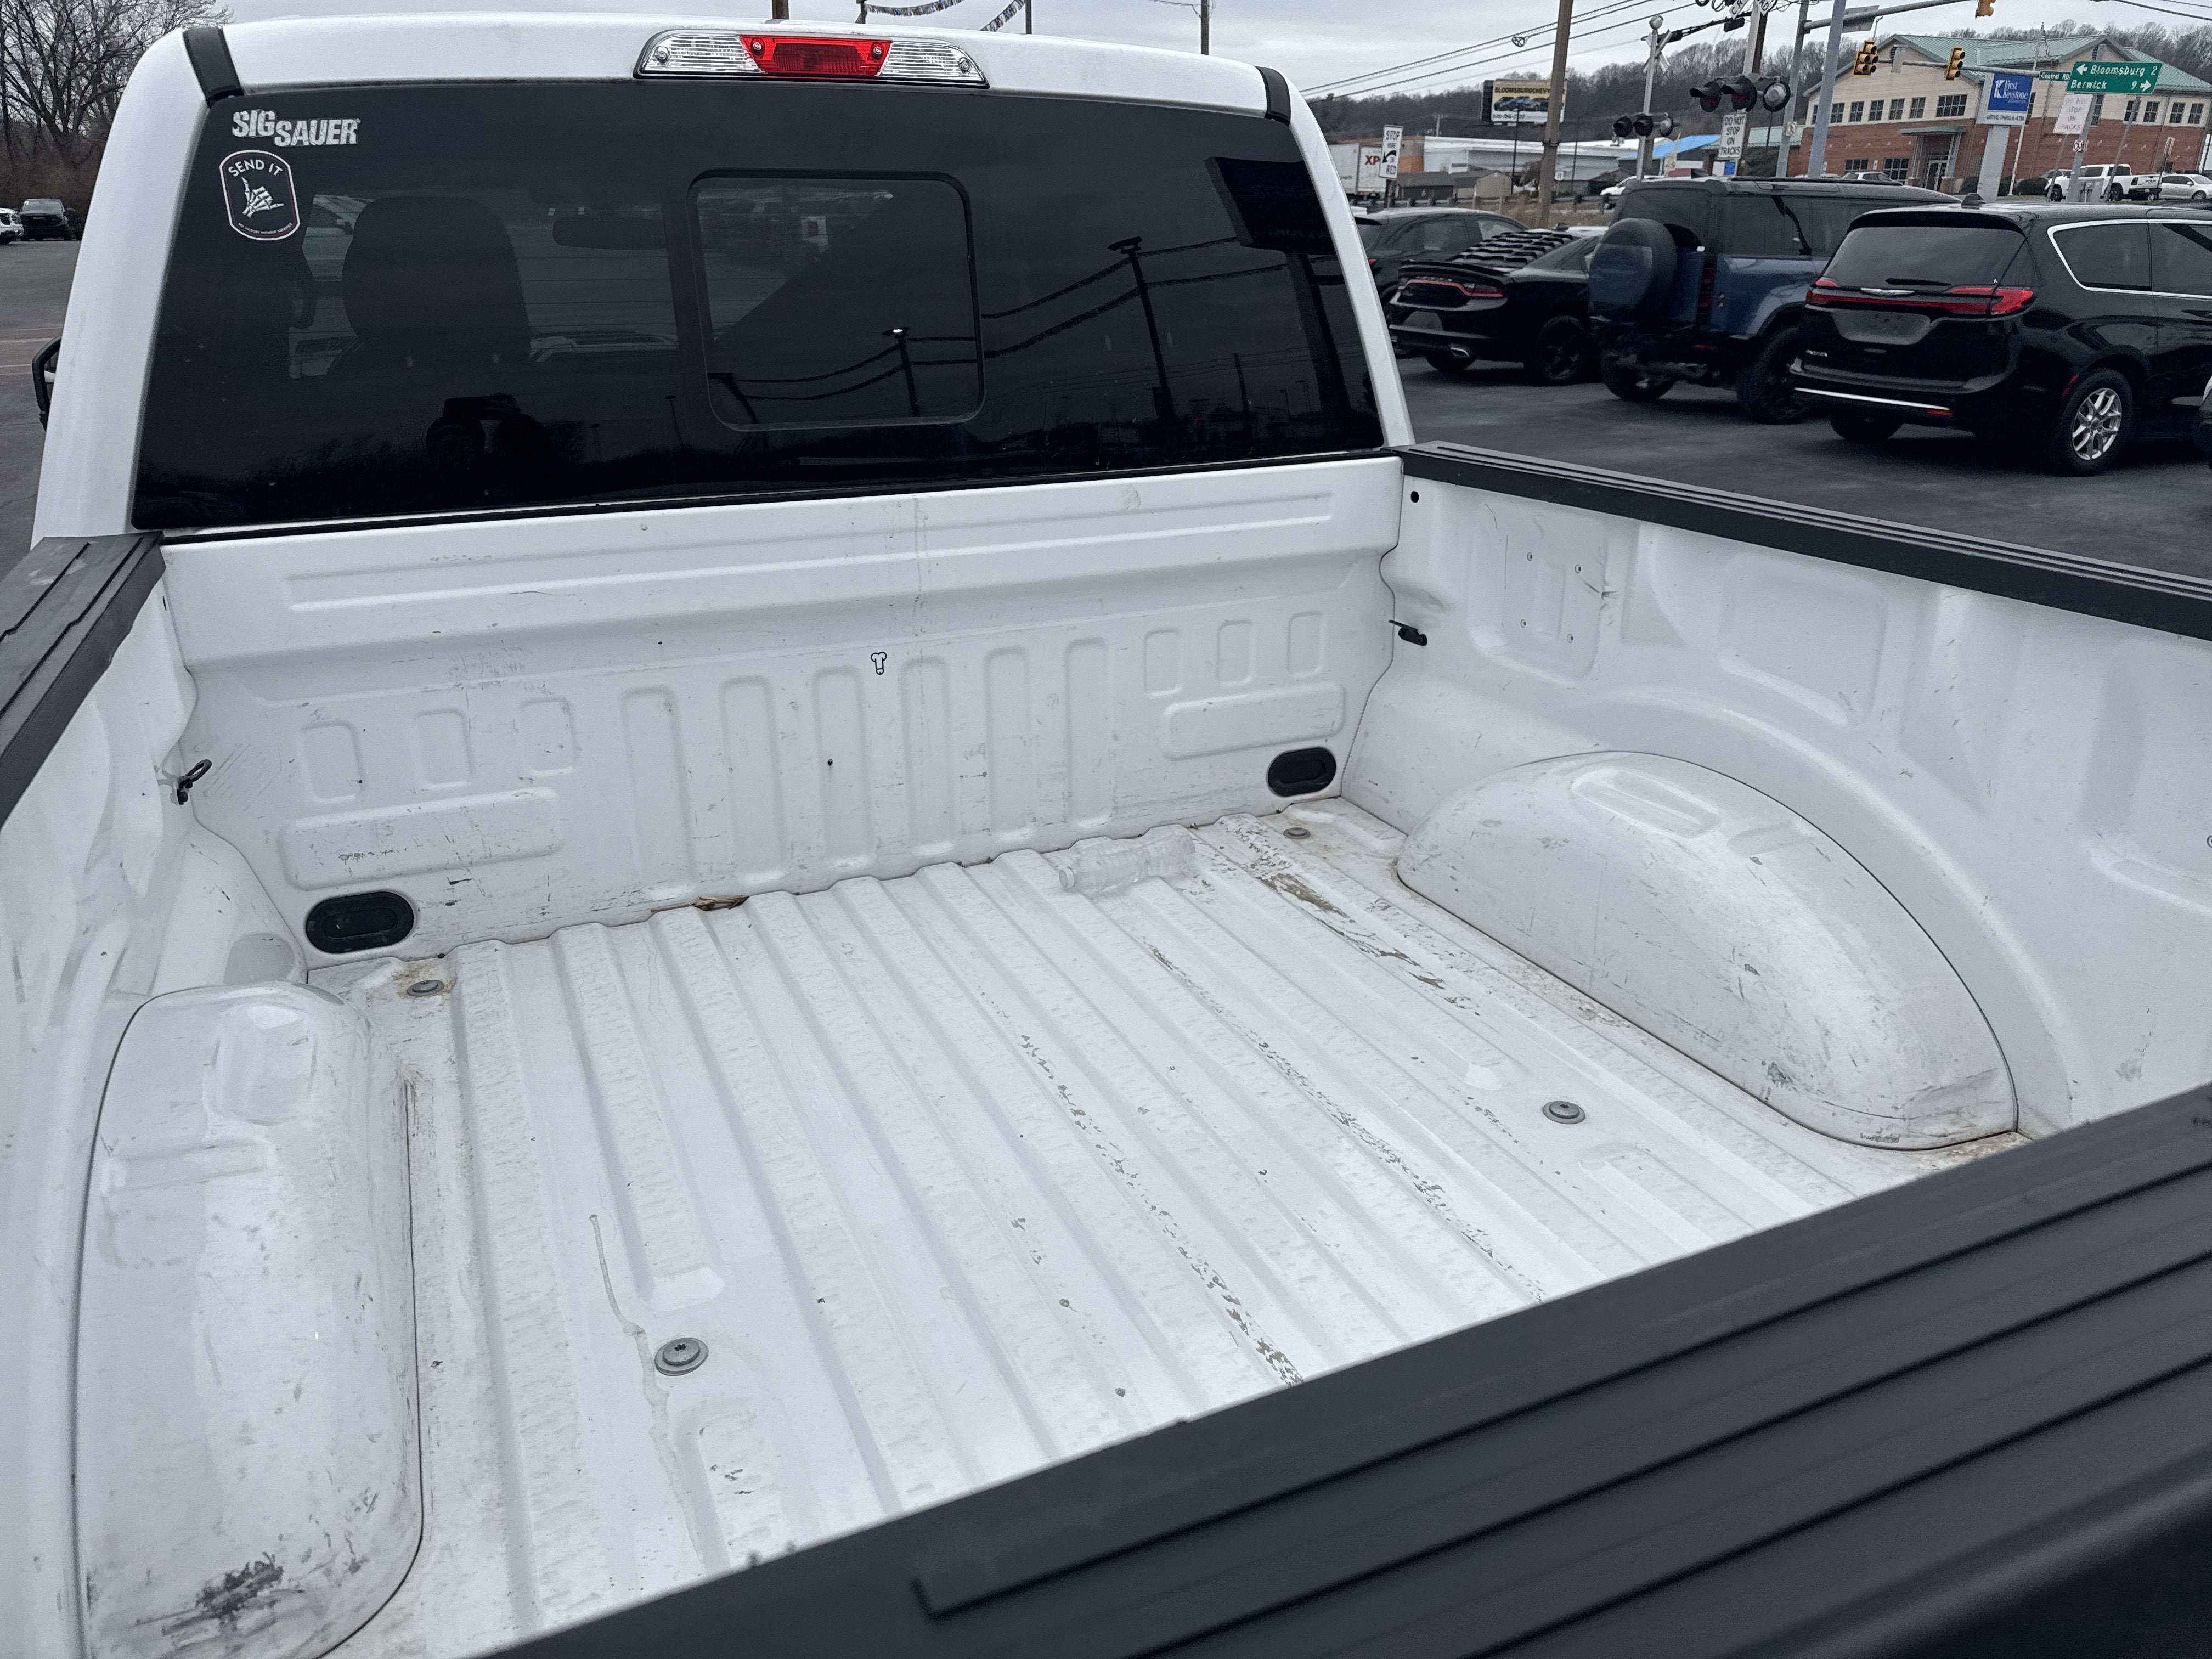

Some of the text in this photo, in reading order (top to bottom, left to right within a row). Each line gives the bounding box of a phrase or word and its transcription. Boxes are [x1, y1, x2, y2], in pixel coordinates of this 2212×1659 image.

[2090, 65, 2157, 77] Bloomsburg 2
[2005, 80, 2018, 90] First
[2070, 80, 2137, 90] Berwick 9
[232, 110, 275, 137] SIG
[1724, 116, 1745, 126] DO NOT
[274, 119, 358, 147] SAUER
[1386, 130, 1400, 140] STOP
[1726, 126, 1740, 136] STOP
[1726, 137, 1735, 145] ON
[1720, 146, 1741, 155] TRACKS
[1365, 155, 1381, 165] XP
[228, 160, 283, 177] SEND IT
[1386, 165, 1396, 174] RED
